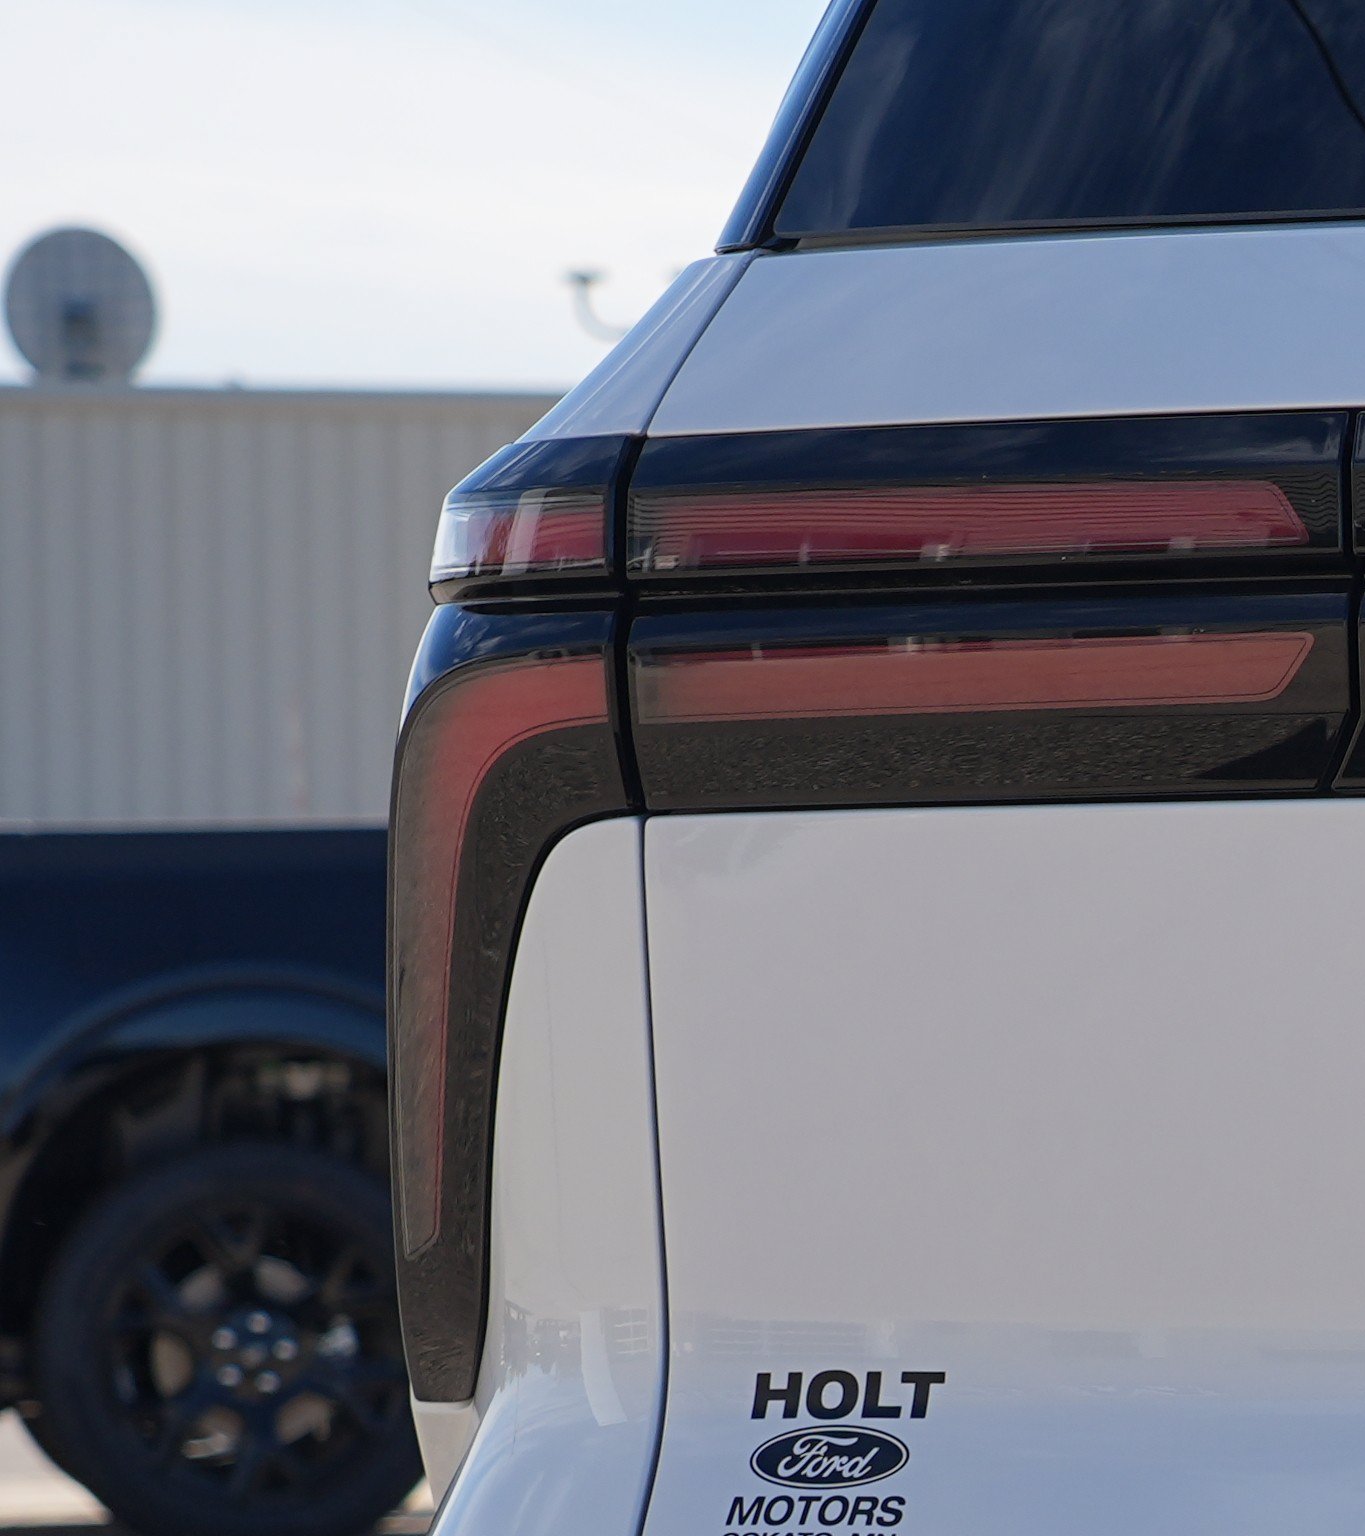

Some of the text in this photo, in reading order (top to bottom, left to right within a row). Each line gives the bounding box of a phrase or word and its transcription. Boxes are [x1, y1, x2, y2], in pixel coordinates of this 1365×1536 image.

[750, 1369, 947, 1421] HOLT
[776, 1434, 881, 1479] Ford
[724, 1494, 907, 1528] MOTORS
